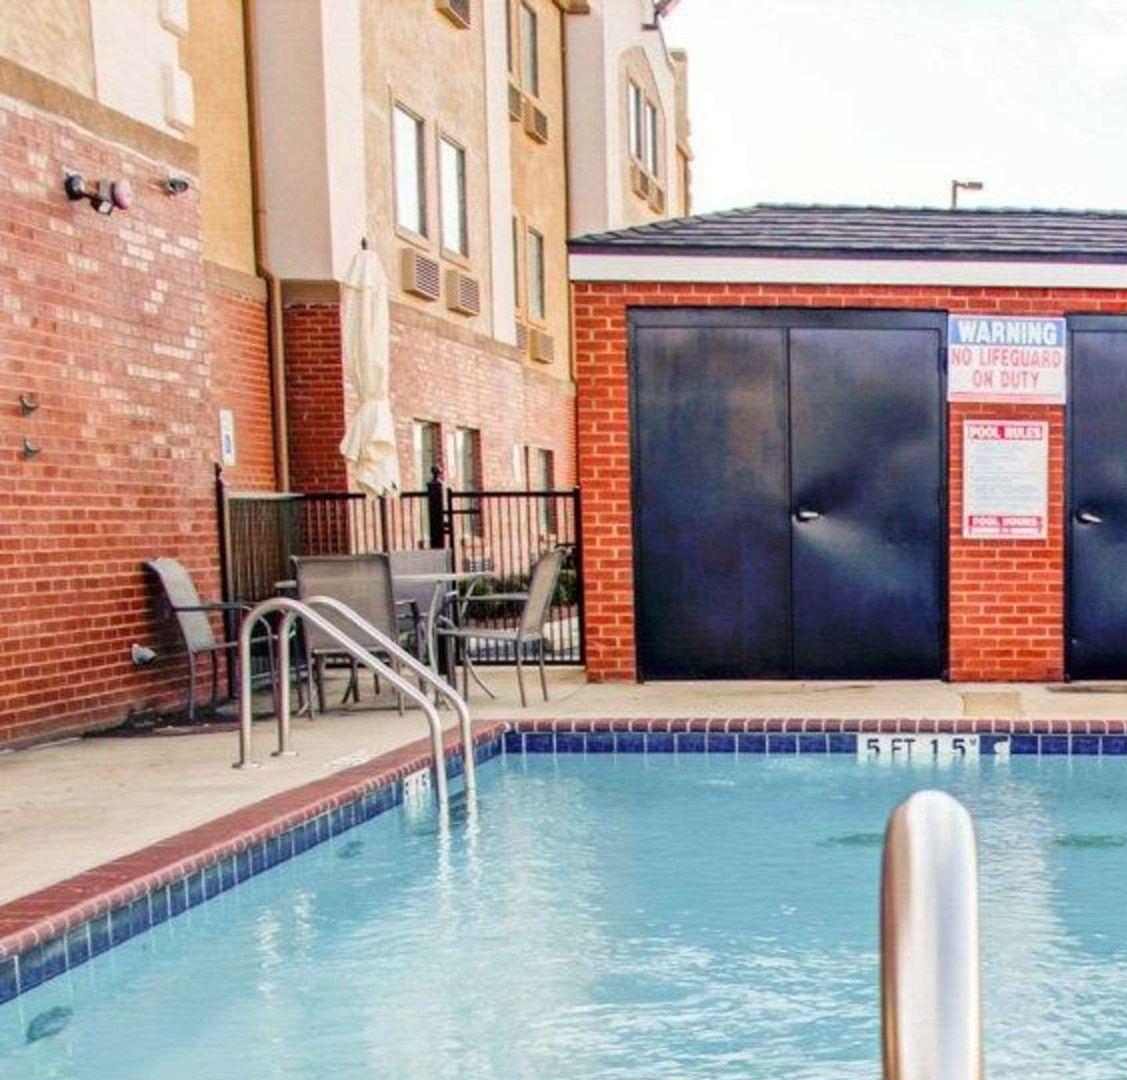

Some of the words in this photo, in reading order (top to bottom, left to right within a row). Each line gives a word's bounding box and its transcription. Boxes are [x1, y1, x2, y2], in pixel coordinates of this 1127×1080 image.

[957, 319, 1057, 345] WARNING
[951, 348, 972, 366] NO
[979, 349, 1061, 368] LIFEGUARD
[972, 370, 993, 388] ON
[1001, 371, 1040, 389] DUTY
[971, 426, 999, 439] POOL
[1004, 426, 1041, 439] RULES
